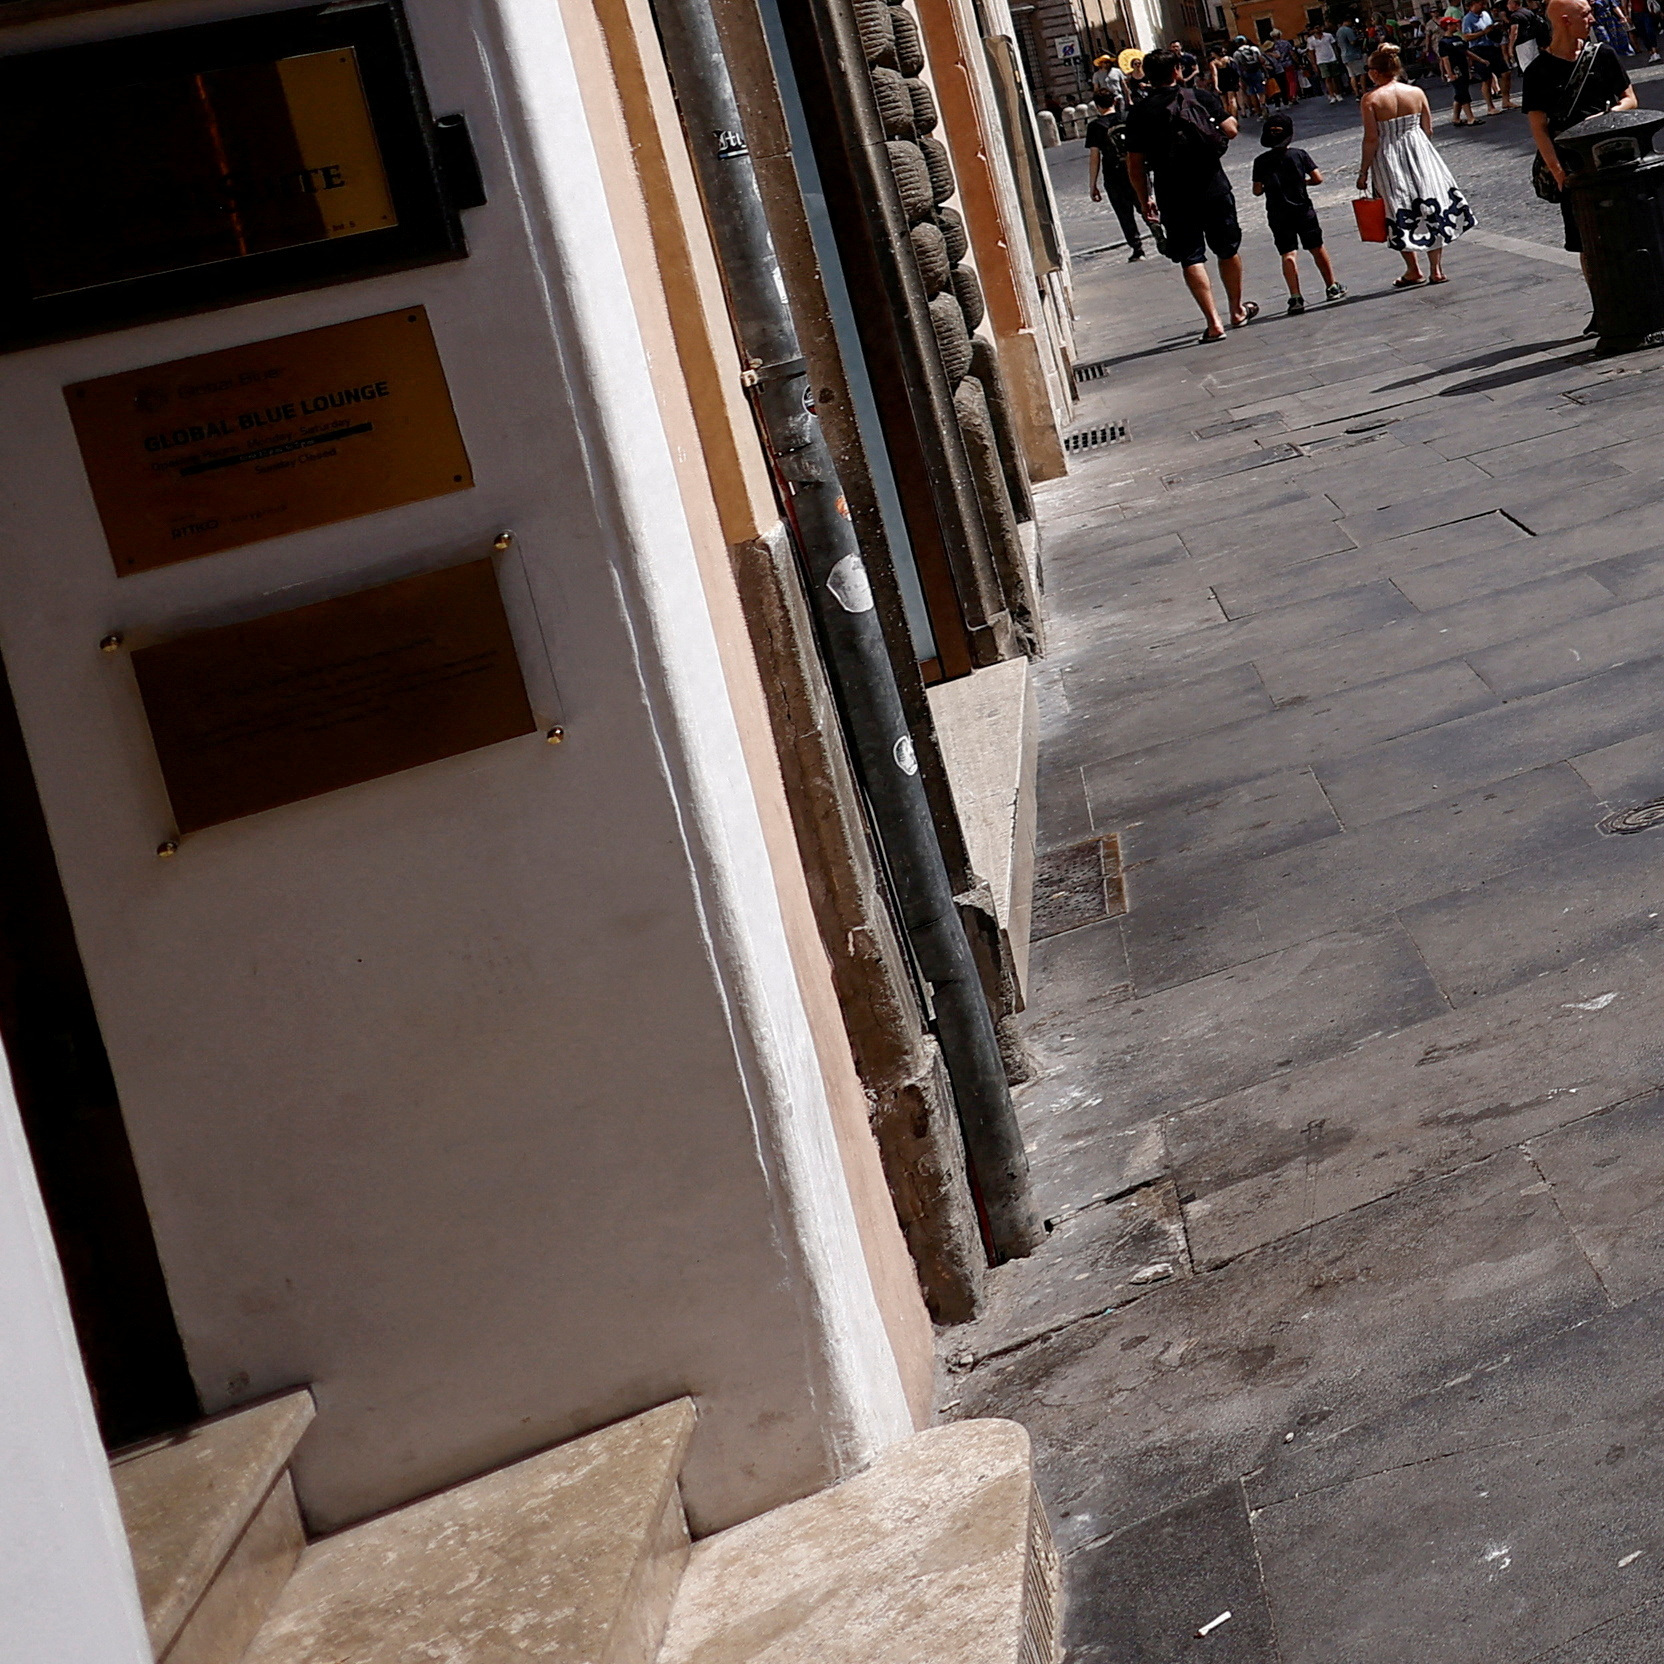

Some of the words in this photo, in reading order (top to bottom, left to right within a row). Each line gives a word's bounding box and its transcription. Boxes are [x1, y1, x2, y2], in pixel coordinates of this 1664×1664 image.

[144, 418, 235, 452] GLOBAL
[238, 402, 298, 431] BLUE
[300, 381, 391, 416] LOUNGE
